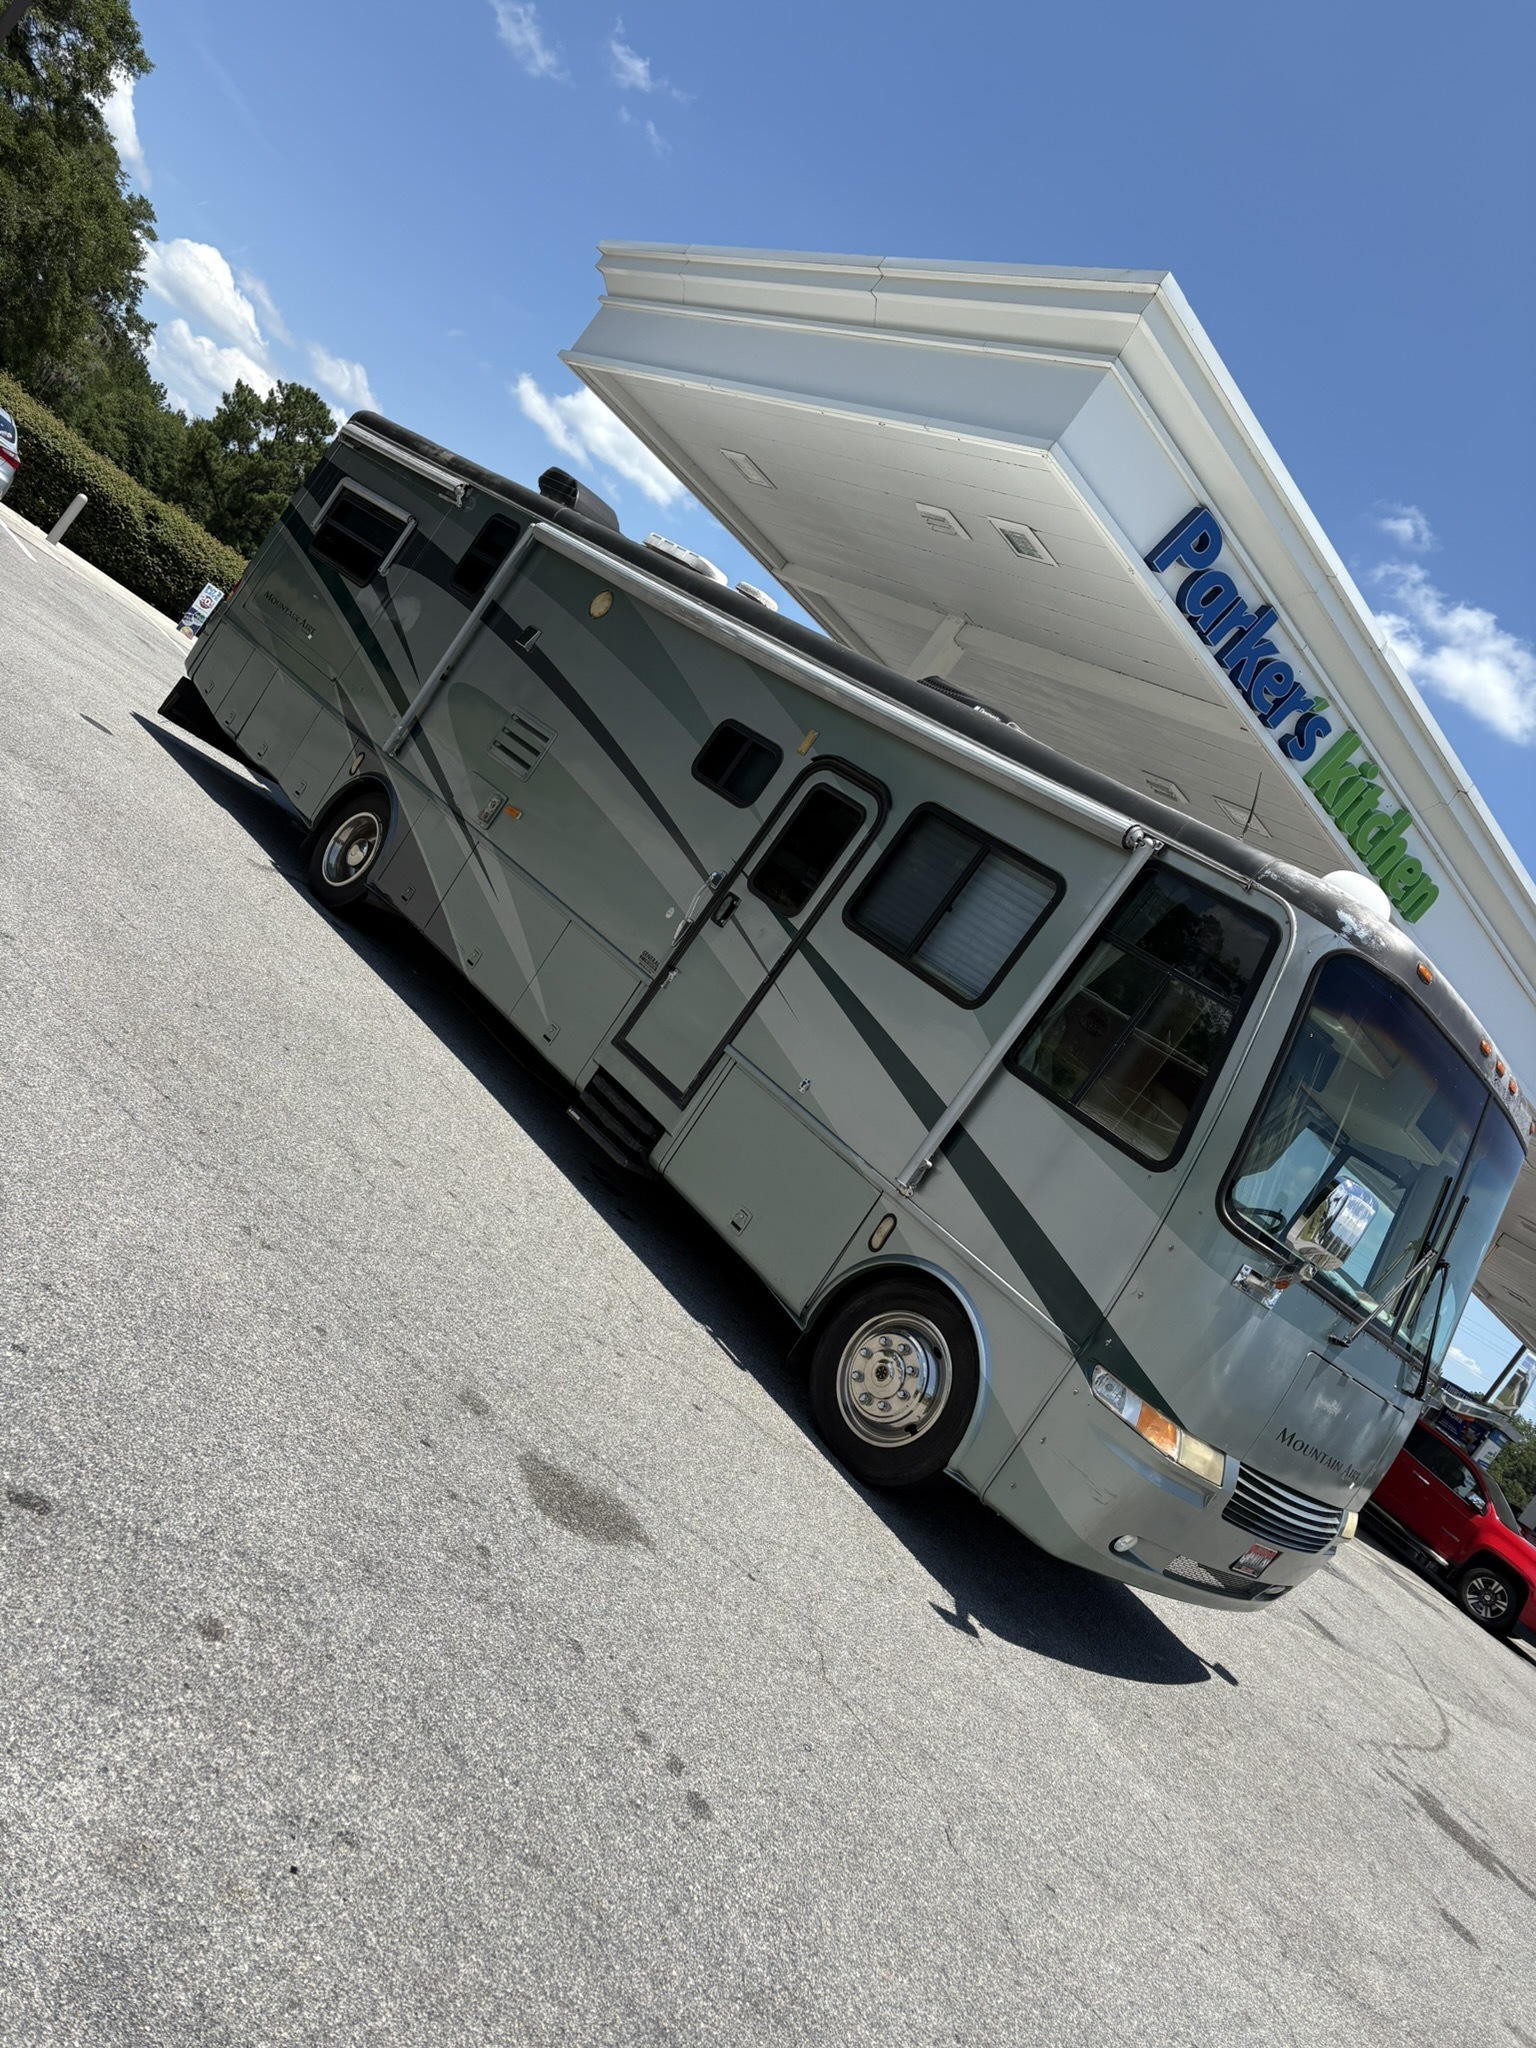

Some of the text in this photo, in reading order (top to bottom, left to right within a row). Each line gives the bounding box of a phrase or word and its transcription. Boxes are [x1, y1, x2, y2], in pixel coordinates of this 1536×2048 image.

[300, 619, 318, 635] AIRE
[1144, 506, 1440, 925] Parker's kitchen
[1275, 1427, 1344, 1473] MOUNTAIN
